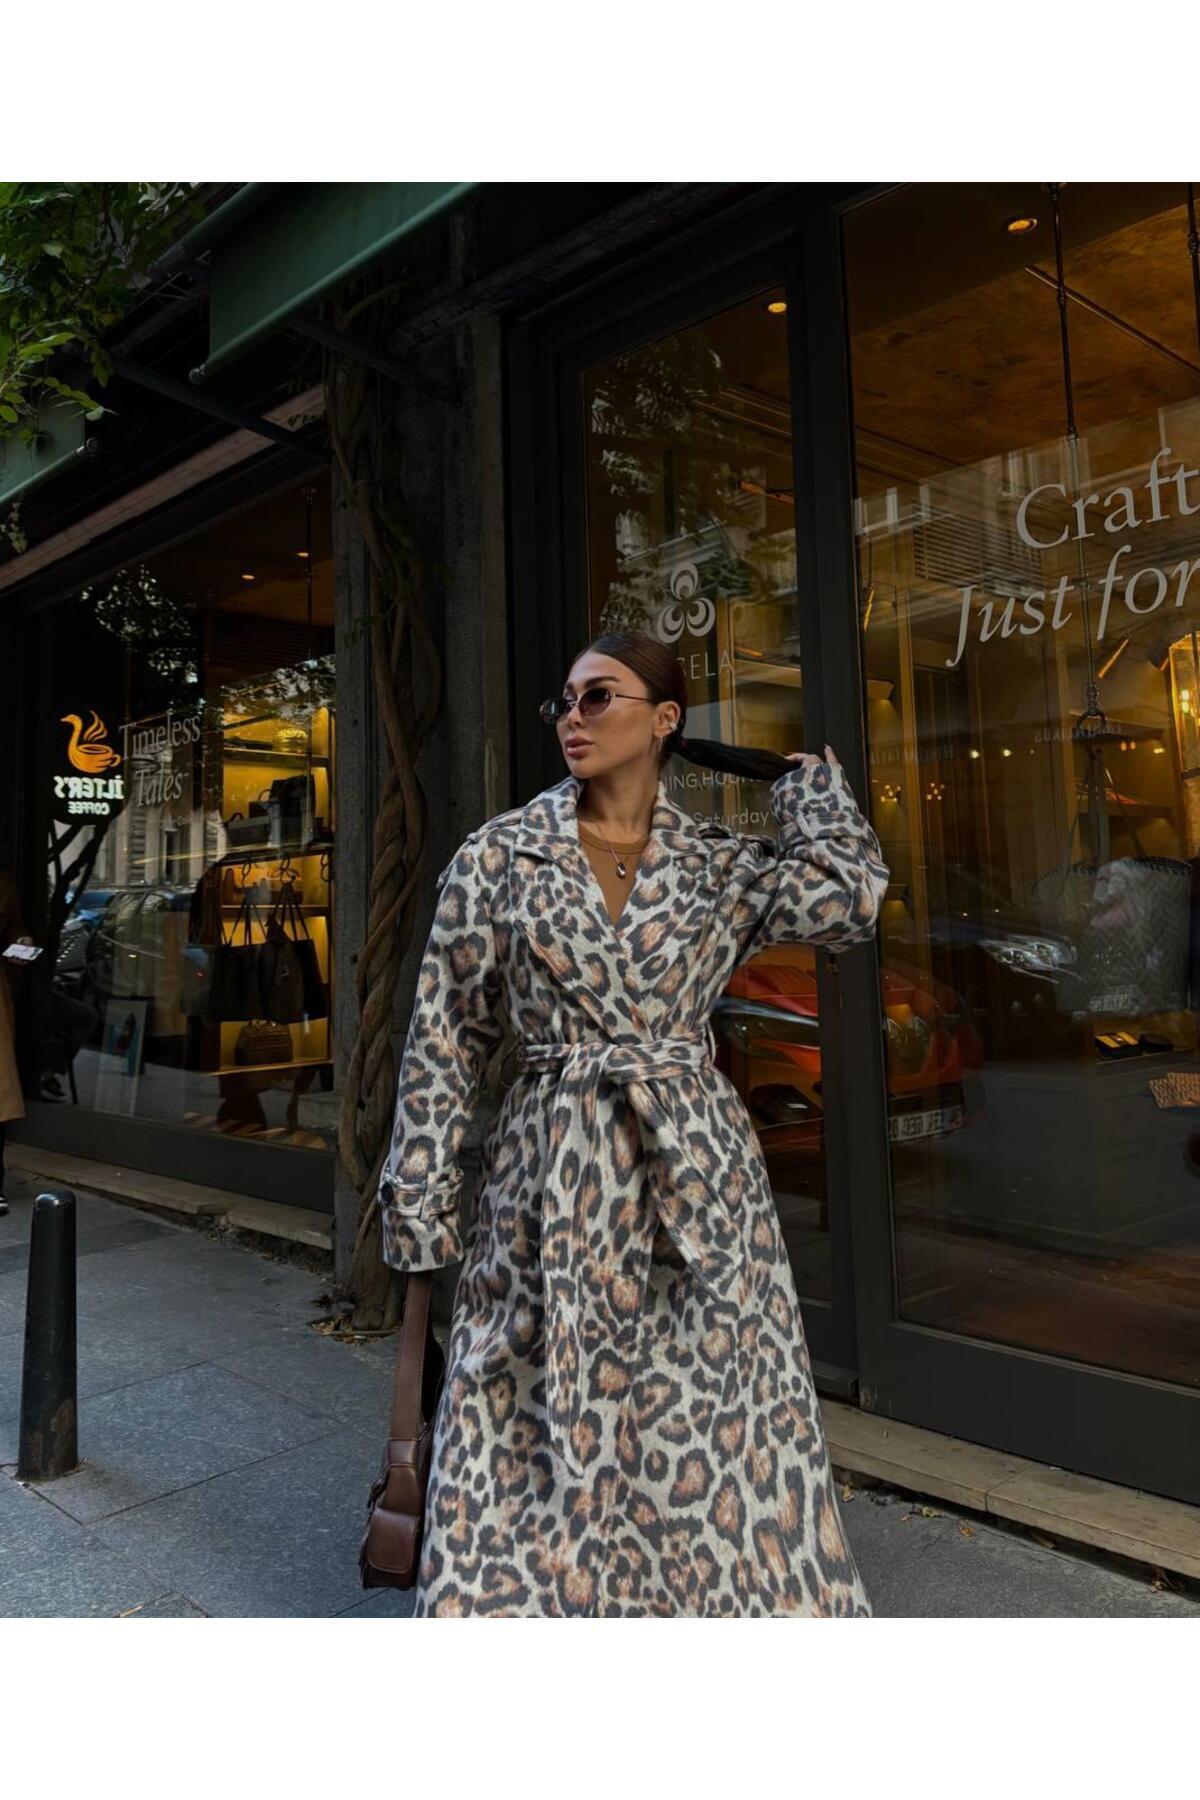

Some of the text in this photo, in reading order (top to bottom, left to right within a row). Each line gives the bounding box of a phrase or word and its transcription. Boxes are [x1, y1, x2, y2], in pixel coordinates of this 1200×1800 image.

[945, 545, 1200, 668] Just for
[118, 709, 201, 762] Timeless
[134, 761, 184, 808] Tales
